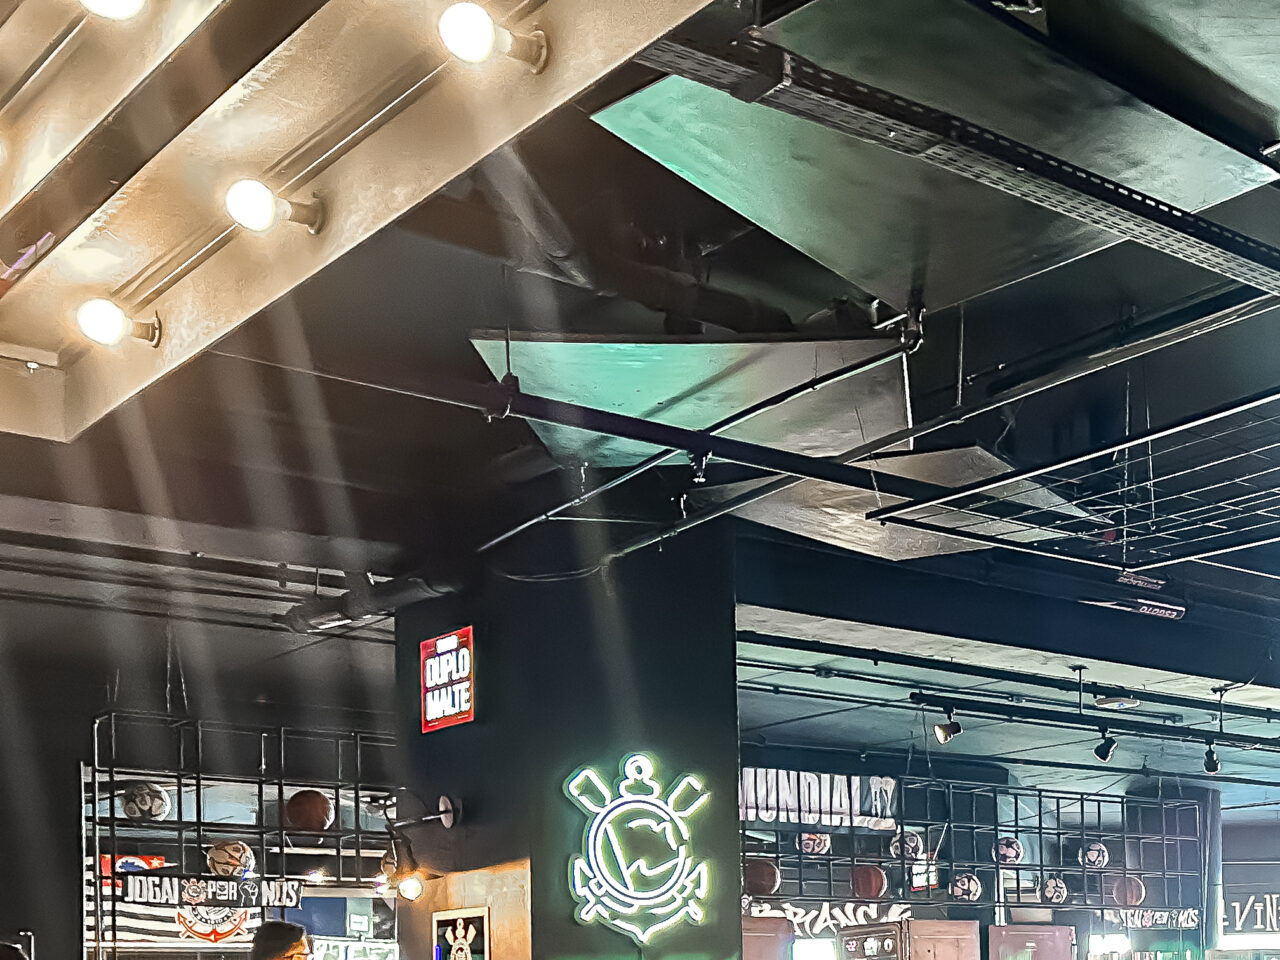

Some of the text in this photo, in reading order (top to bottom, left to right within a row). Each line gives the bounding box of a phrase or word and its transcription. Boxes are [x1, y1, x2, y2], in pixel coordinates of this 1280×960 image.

[1140, 606, 1176, 618] ESGOTO
[425, 647, 471, 688] DUPLO
[425, 681, 471, 722] MALTE
[124, 875, 179, 904] JOGAI
